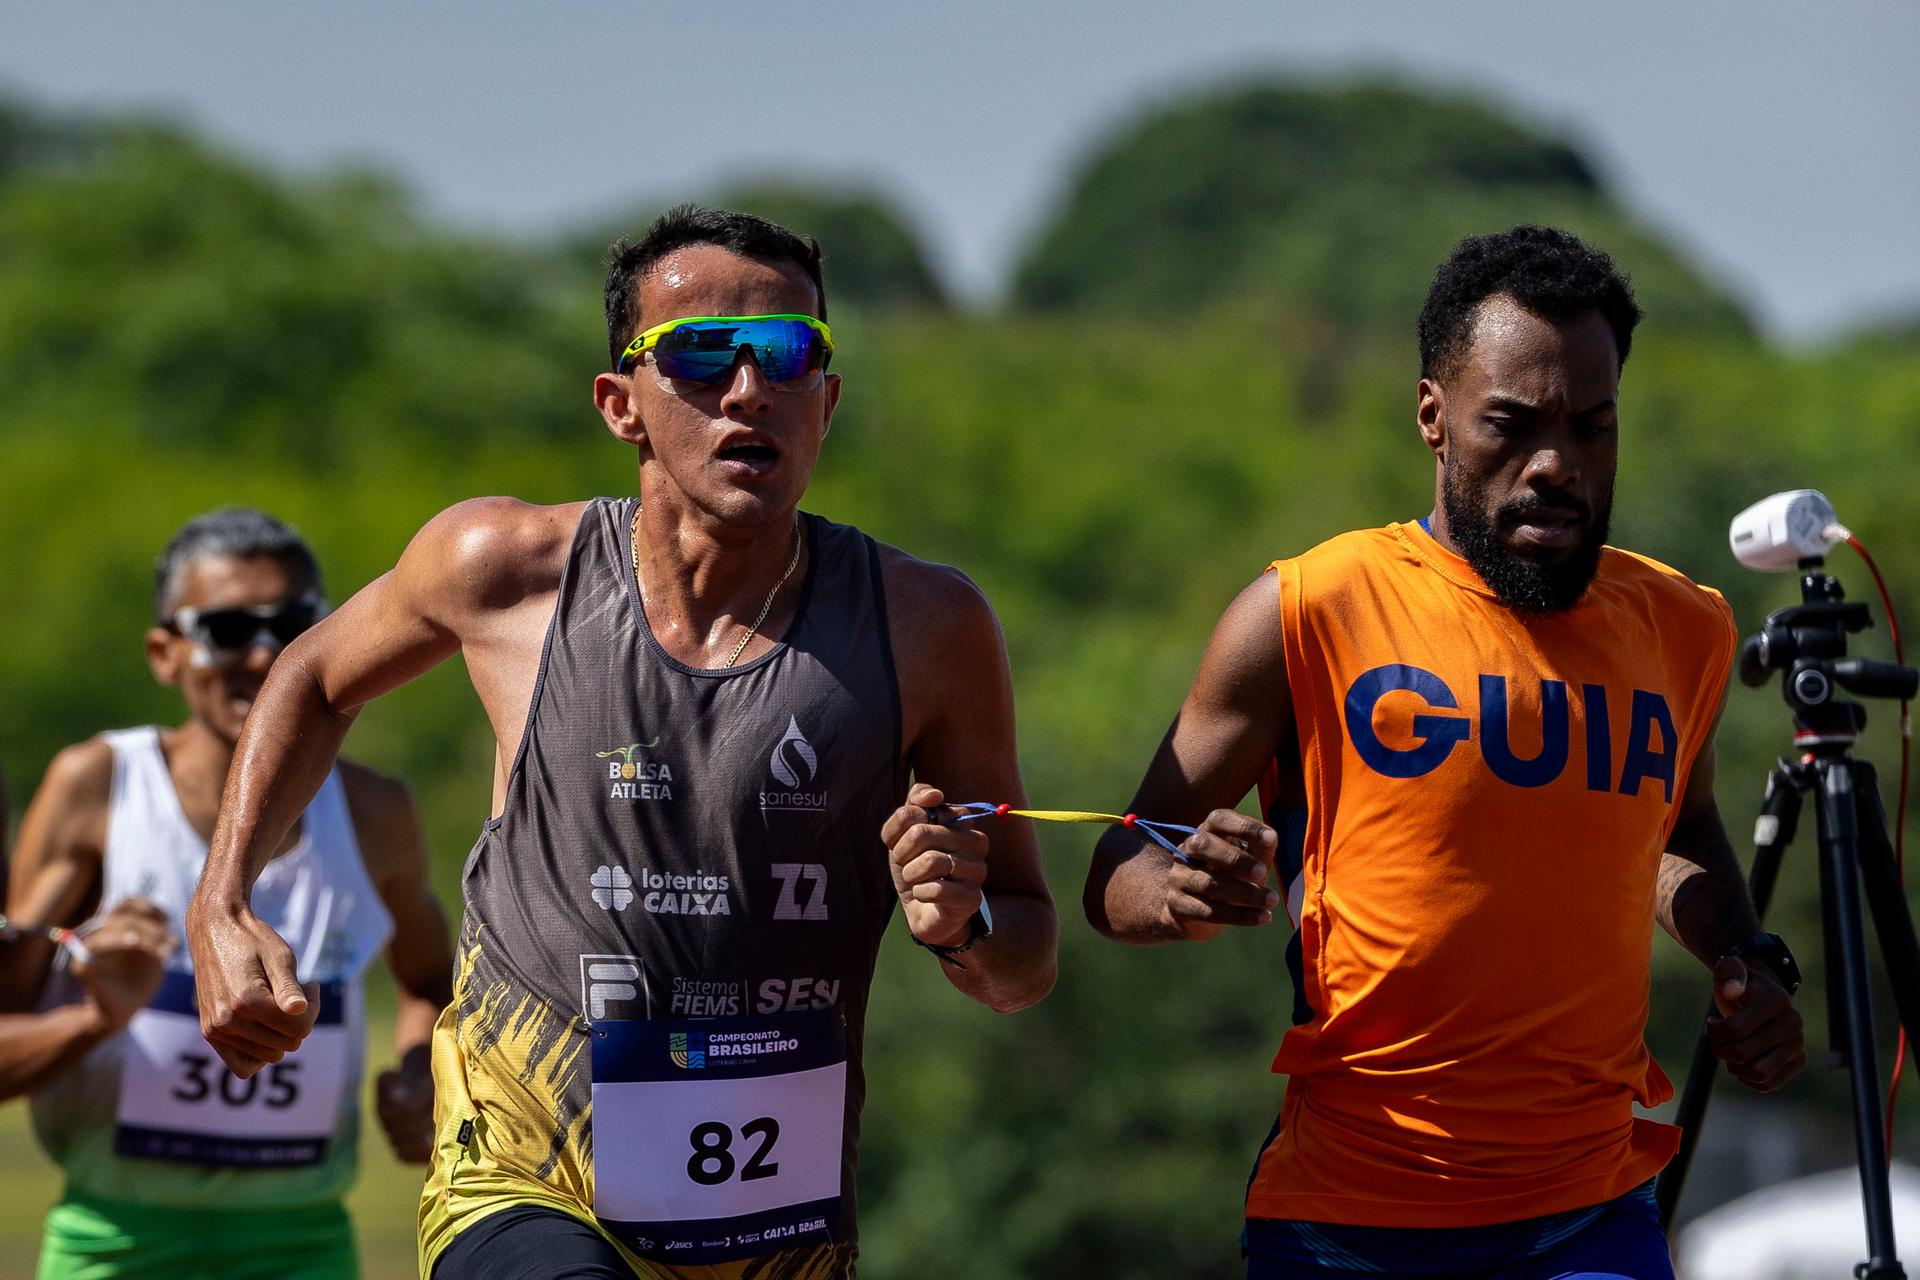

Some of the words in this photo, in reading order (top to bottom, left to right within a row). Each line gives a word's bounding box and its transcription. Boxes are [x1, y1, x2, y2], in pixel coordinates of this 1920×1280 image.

[1344, 663, 1678, 805] GUIA
[609, 762, 673, 782] BOLSA
[610, 783, 673, 800] ATLETA
[759, 791, 827, 806] sanesul
[642, 868, 729, 891] loterias
[643, 892, 731, 916] CAIXA
[672, 977, 739, 995] Sistema
[670, 994, 740, 1016] FIEMS
[709, 1030, 780, 1043] CAMPEONATO
[709, 1038, 799, 1057] BRASILEIRO
[172, 1054, 304, 1108] 305
[686, 1116, 780, 1186] 82
[763, 1225, 796, 1240] CAIXA
